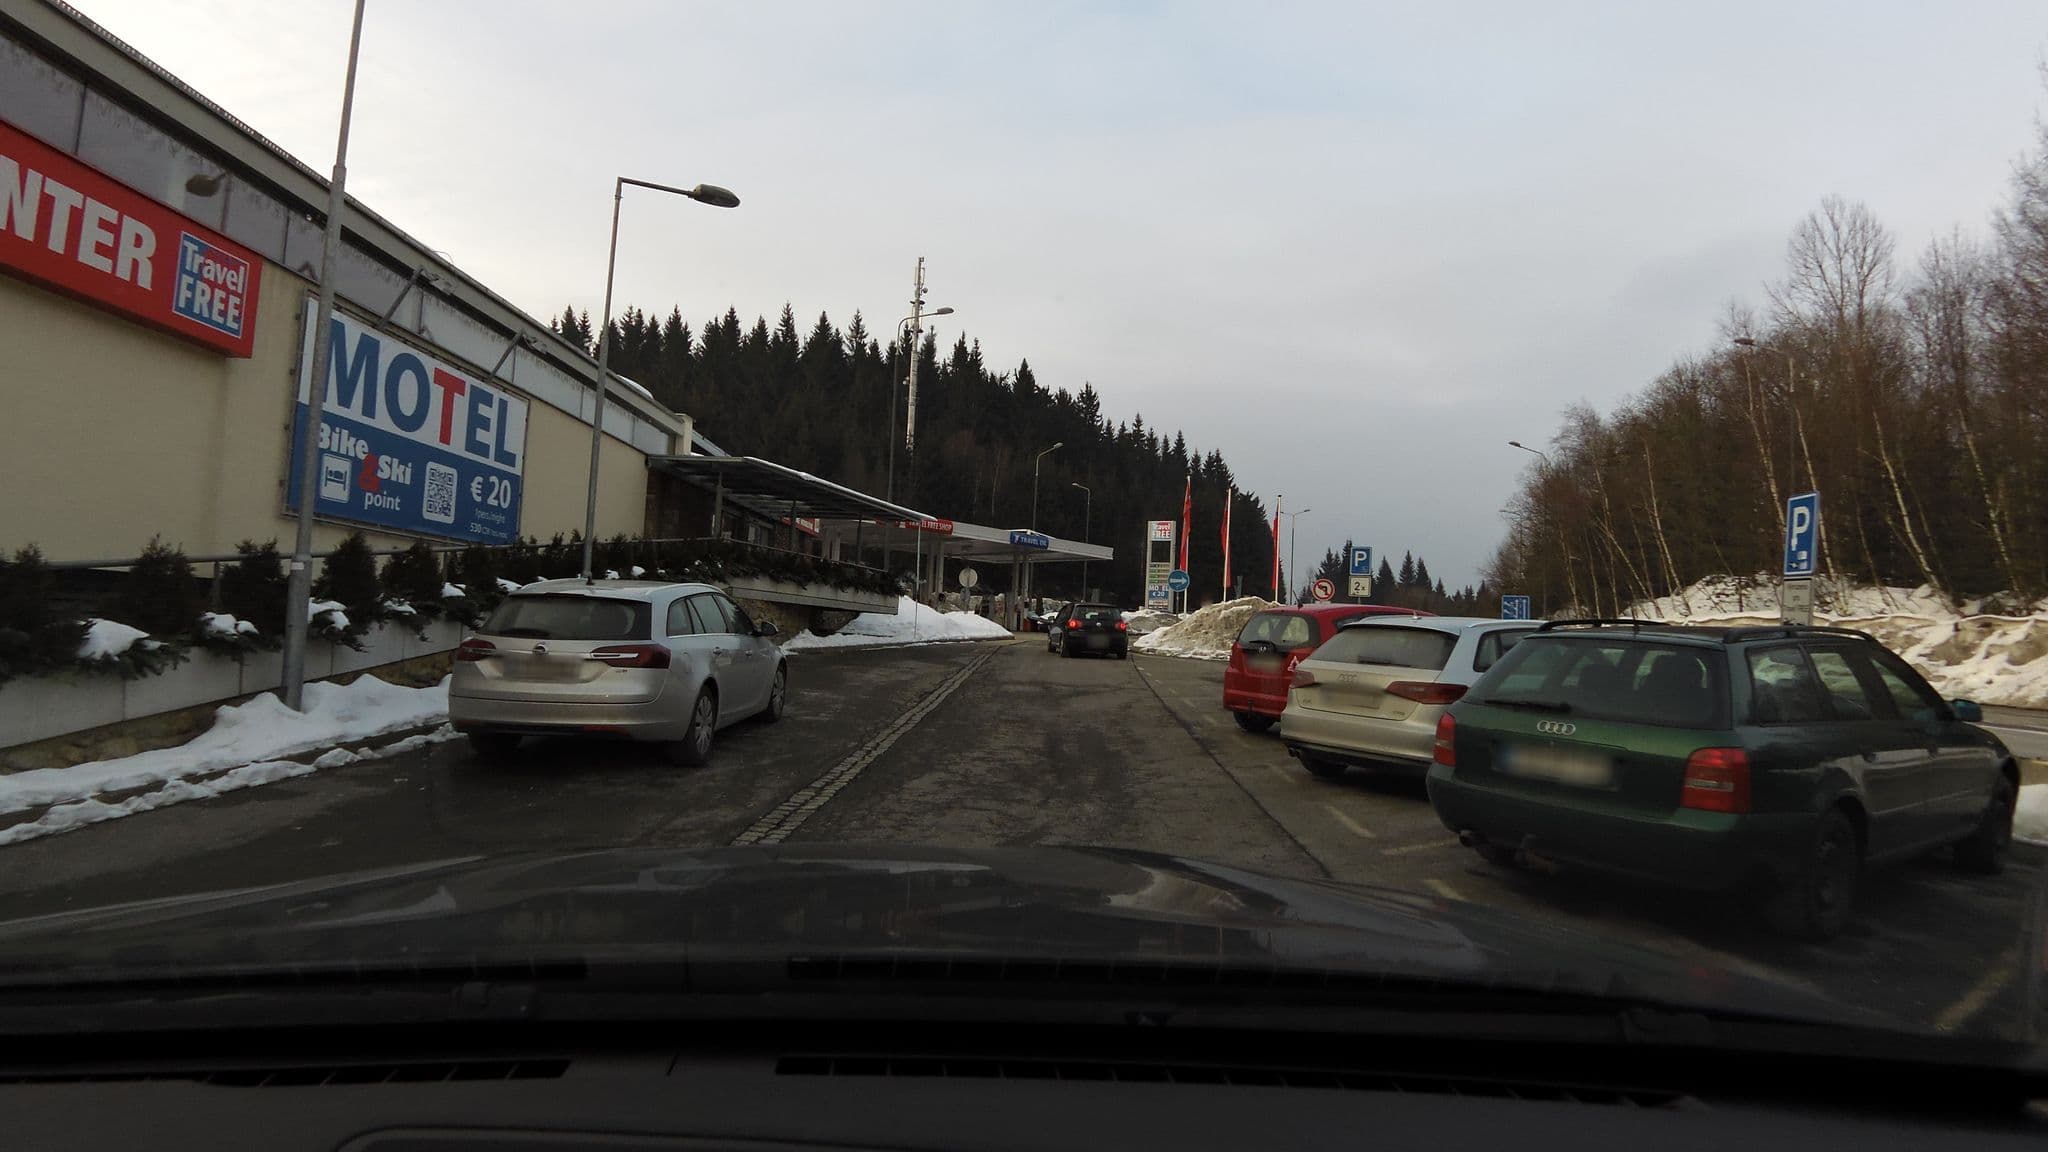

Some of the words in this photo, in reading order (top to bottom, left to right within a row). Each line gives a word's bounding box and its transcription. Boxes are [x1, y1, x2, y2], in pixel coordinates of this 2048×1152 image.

[183, 241, 246, 294] Travel
[179, 275, 242, 330] FREE
[323, 318, 518, 468] MOTEL
[317, 422, 369, 462] Bike
[376, 454, 413, 485] Ski
[364, 490, 401, 512] point
[470, 476, 483, 502] €
[487, 475, 511, 509] 20
[1791, 506, 1810, 551] P
[1355, 551, 1367, 567] P
